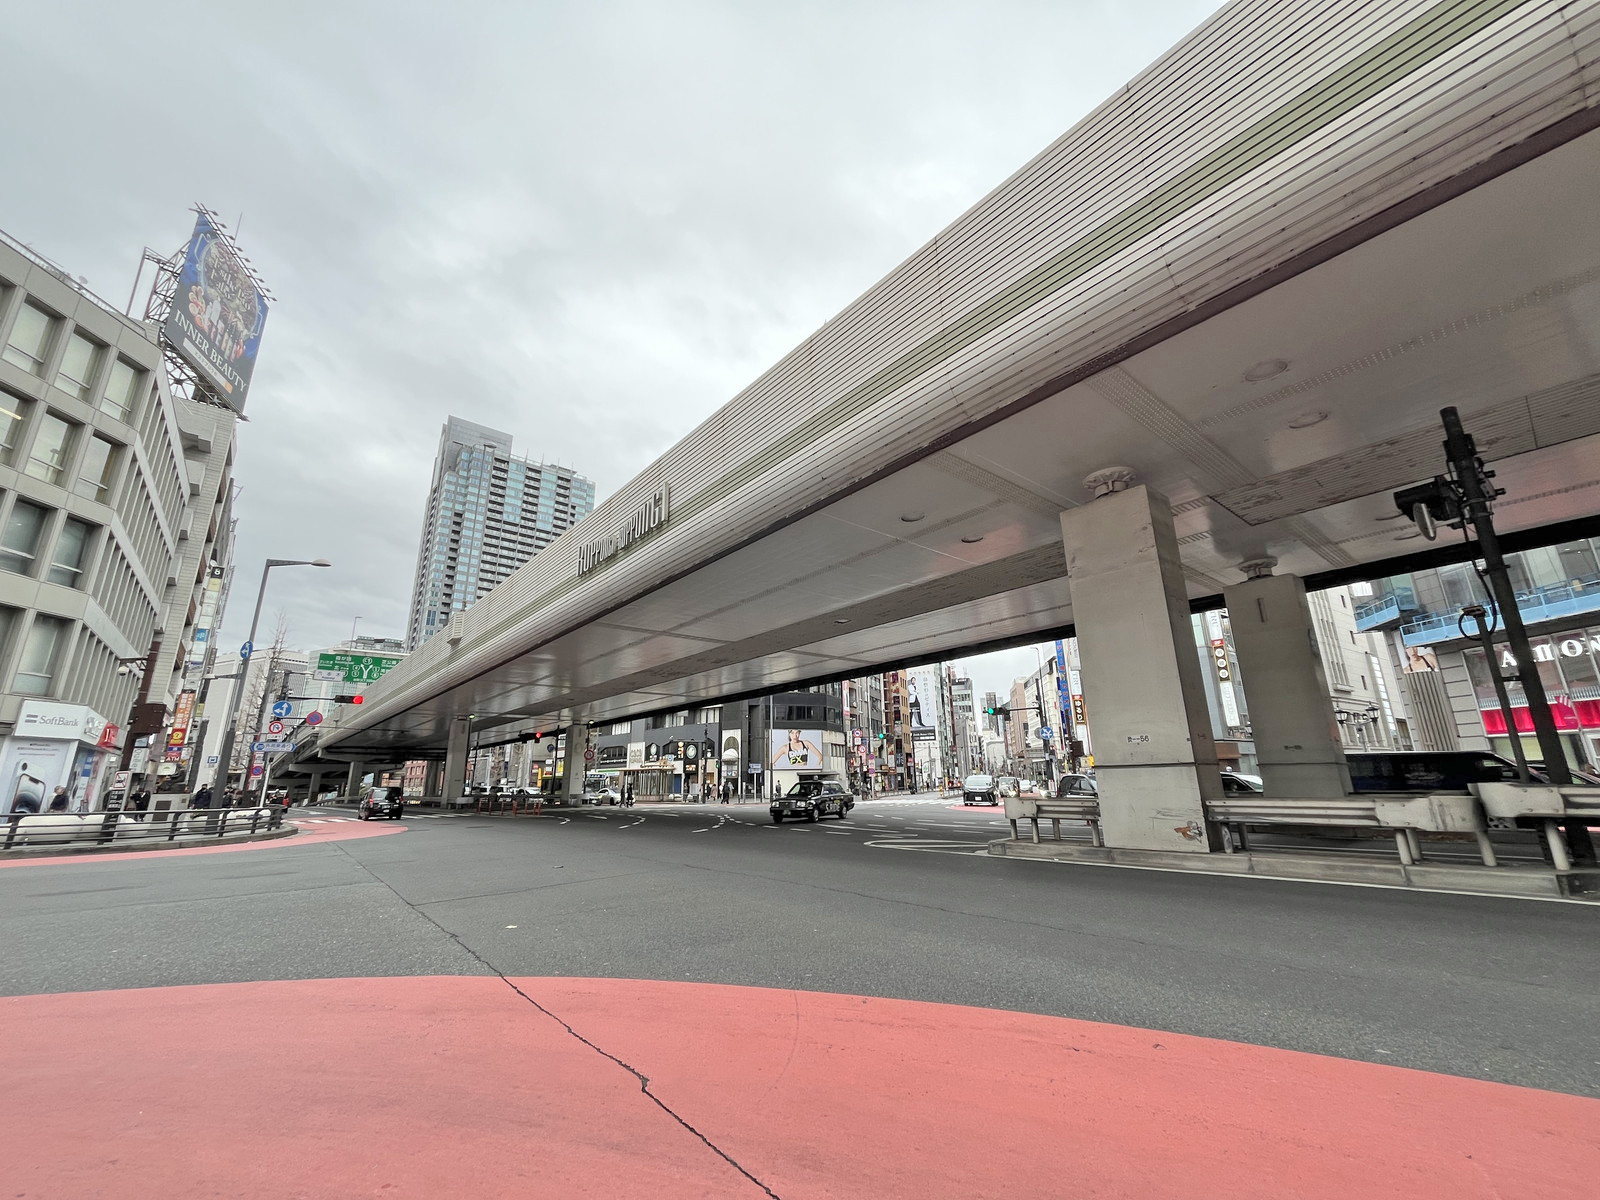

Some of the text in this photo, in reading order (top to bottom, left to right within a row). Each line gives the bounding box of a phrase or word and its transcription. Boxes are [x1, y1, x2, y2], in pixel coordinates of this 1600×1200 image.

[174, 309, 247, 392] INNER BEAUTY
[38, 715, 80, 727] SoftBank
[790, 755, 803, 764] FX
